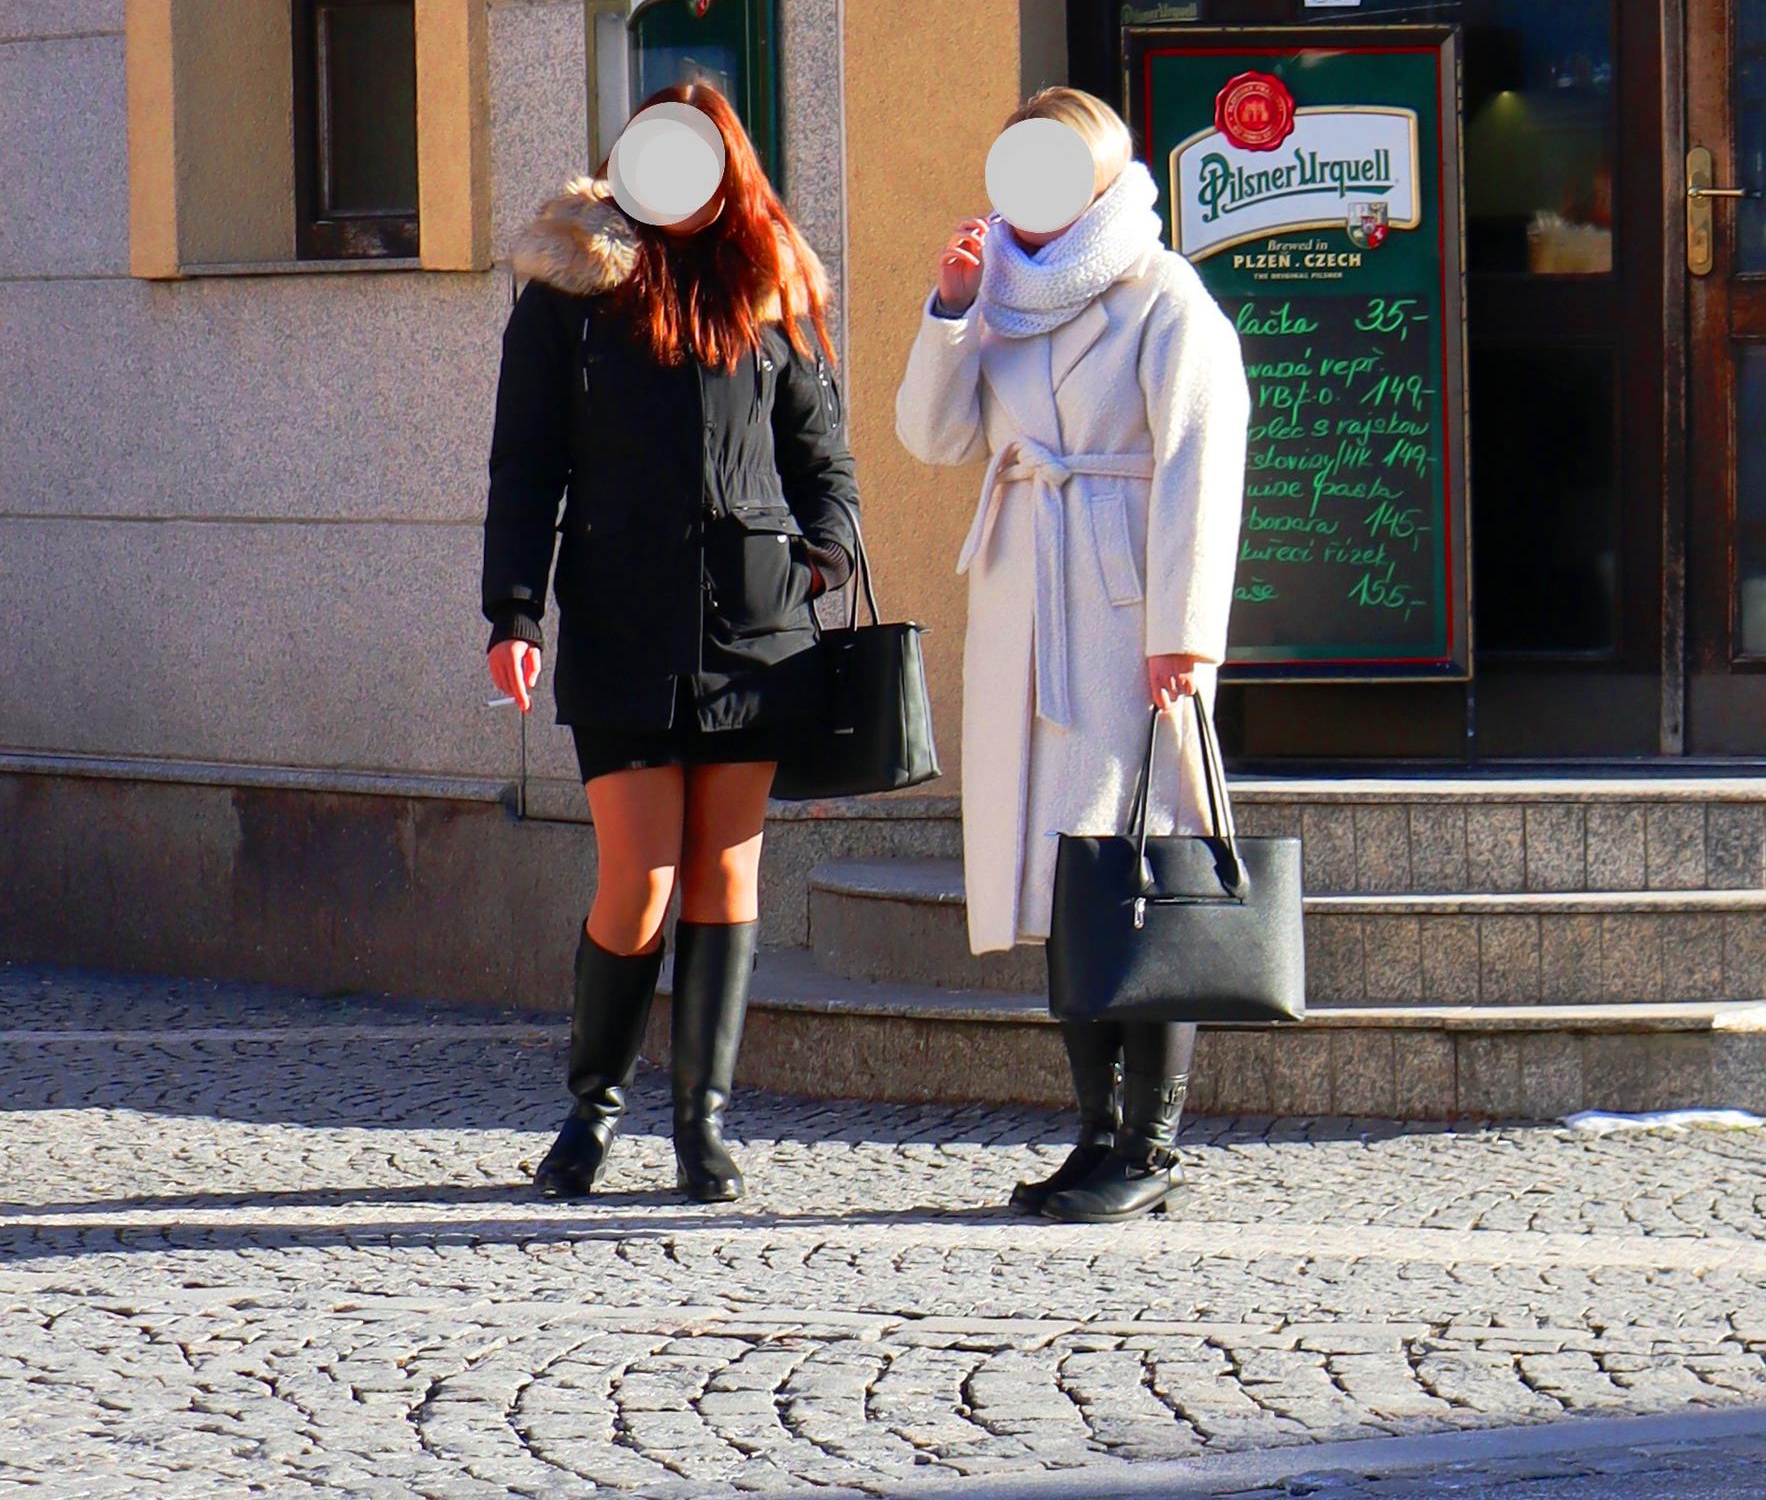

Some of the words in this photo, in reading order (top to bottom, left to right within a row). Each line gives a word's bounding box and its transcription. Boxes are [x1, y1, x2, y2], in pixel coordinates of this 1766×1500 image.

[1197, 152, 1298, 223] Pilsner
[1294, 147, 1391, 199] Urquell
[1267, 239, 1313, 251] Brewed
[1315, 239, 1329, 251] in
[1304, 253, 1362, 268] CZECH
[1248, 347, 1314, 379] vaná
[1242, 506, 1340, 536] bonara
[1234, 576, 1281, 603] aše
